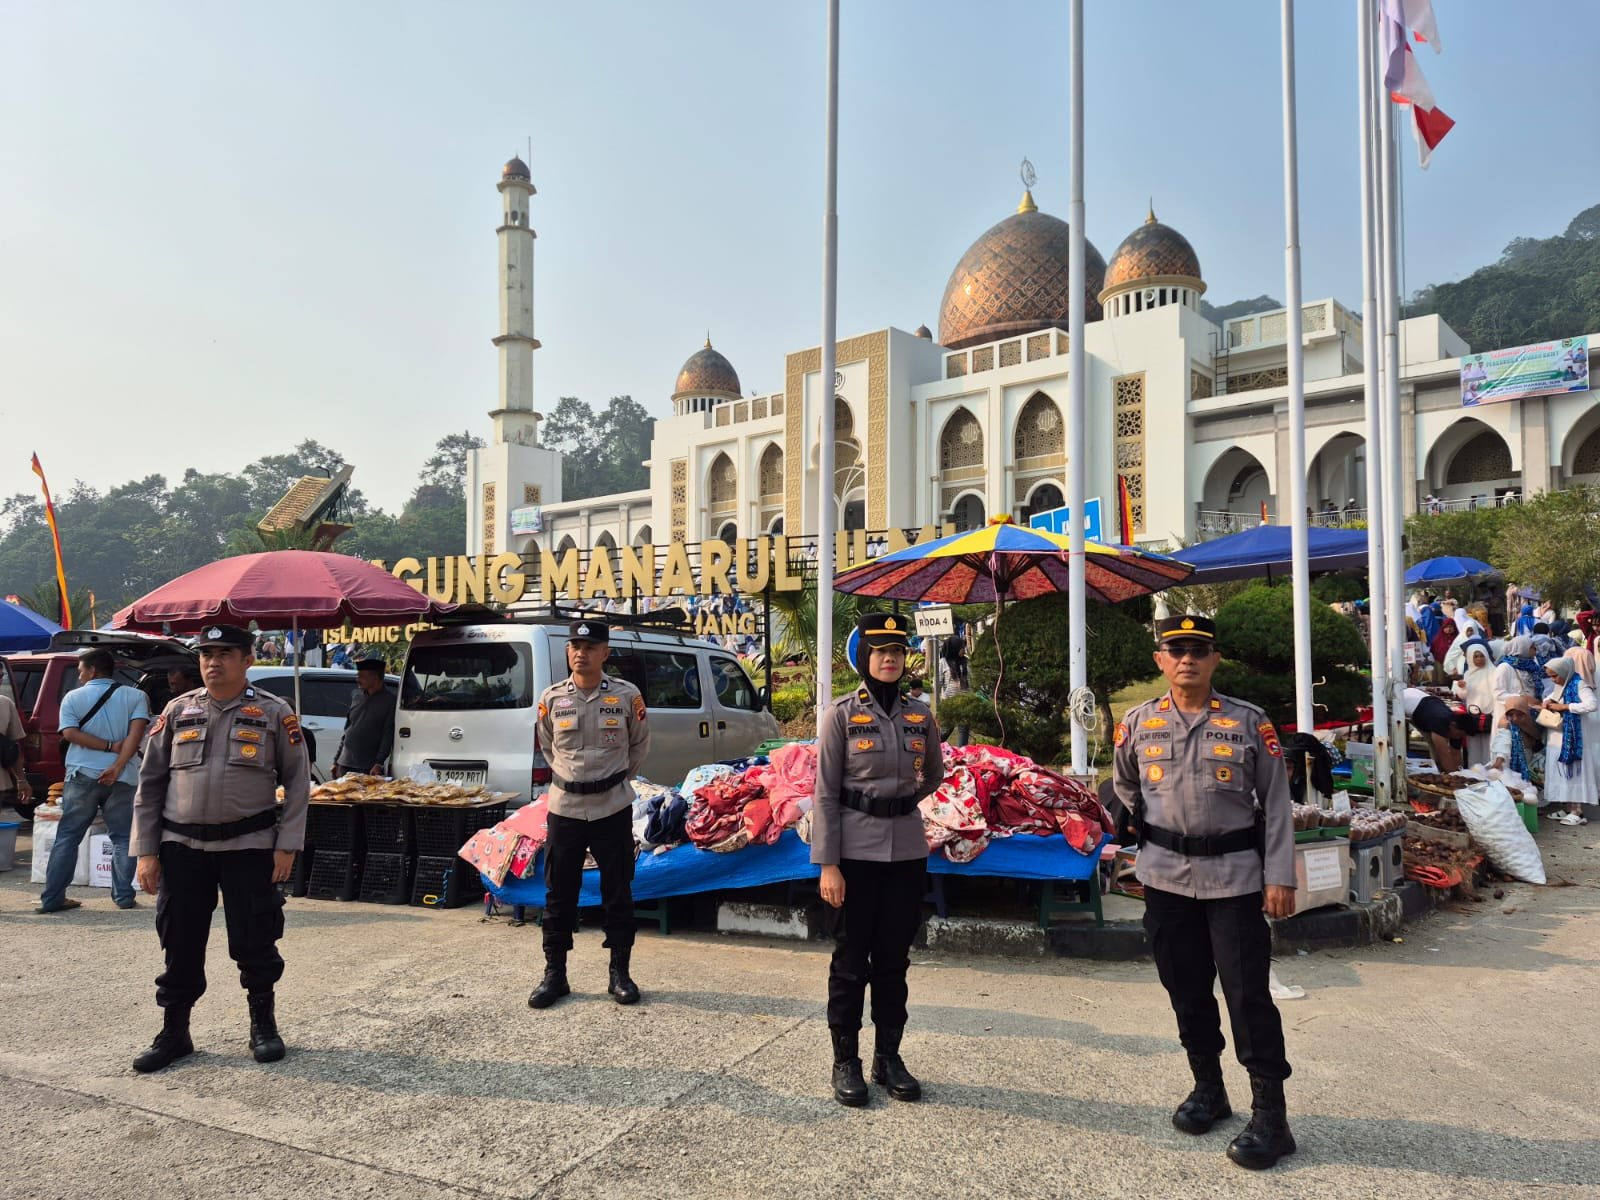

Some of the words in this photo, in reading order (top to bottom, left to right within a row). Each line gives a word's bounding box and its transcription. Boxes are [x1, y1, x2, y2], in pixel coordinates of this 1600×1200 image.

[371, 551, 525, 604] GUNG
[541, 535, 802, 601] MANARUL
[919, 618, 941, 627] RODA
[943, 617, 948, 625] 4
[322, 625, 400, 645] ISLAMIC
[1206, 731, 1244, 743] POLRI
